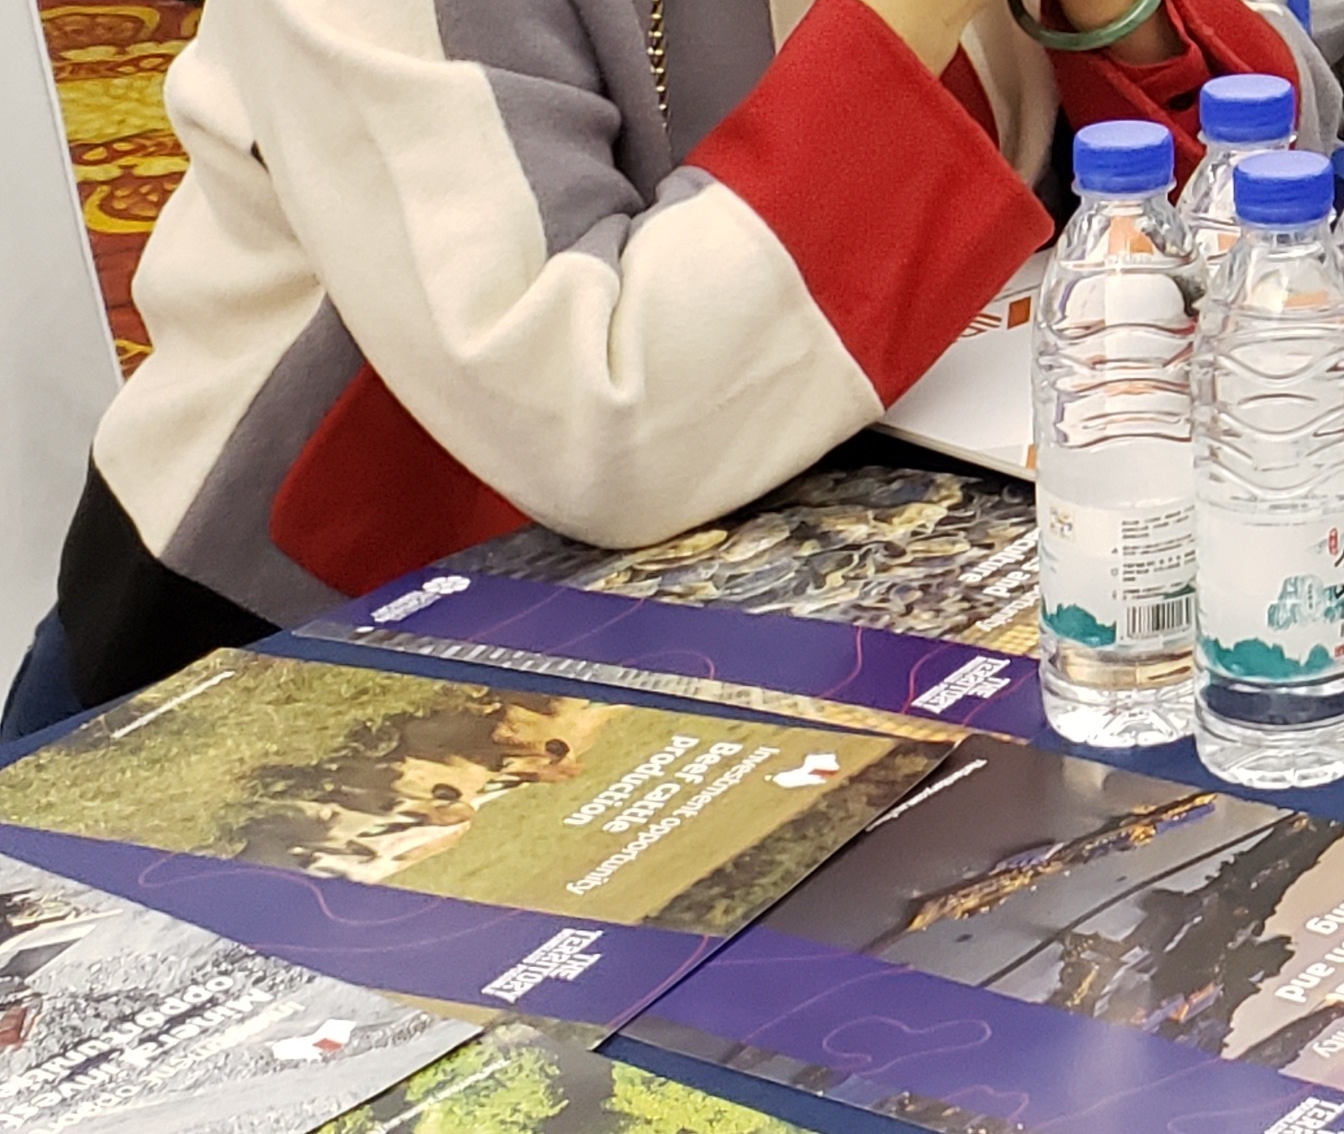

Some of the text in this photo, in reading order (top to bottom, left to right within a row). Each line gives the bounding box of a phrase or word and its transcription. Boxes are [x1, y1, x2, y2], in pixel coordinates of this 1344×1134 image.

[562, 734, 700, 827] production
[602, 741, 744, 834] Beef cattle
[674, 746, 781, 819] Investment
[566, 815, 682, 896] opportunity
[495, 929, 604, 1004] TERRITORY
[550, 953, 602, 981] THE
[1274, 962, 1336, 1004] and
[118, 987, 276, 1068] Mineral
